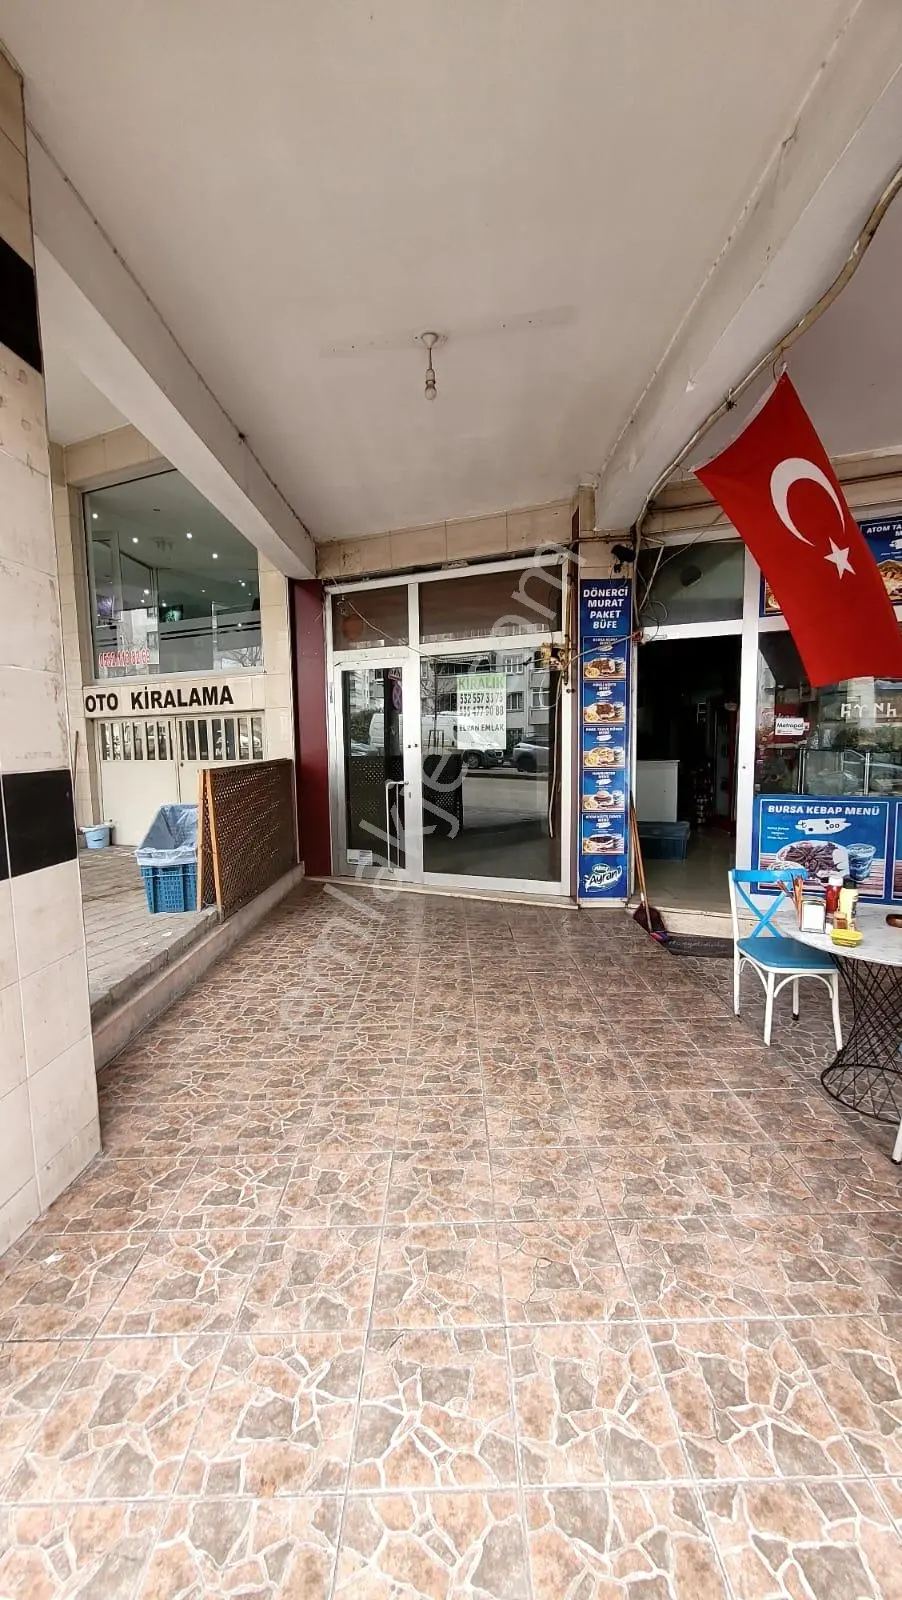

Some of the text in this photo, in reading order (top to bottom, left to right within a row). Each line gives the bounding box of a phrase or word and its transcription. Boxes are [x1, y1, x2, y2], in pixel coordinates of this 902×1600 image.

[866, 525, 890, 534] ATOM
[583, 586, 629, 598] DÖNERCİ
[587, 598, 625, 608] MURAT
[589, 610, 622, 619] PAKET
[592, 619, 618, 629] BÜFE
[85, 685, 234, 712] OTO KİRALAMA
[768, 805, 880, 816] BURSA KEBAP MENÜ
[589, 869, 619, 885] Ayran
